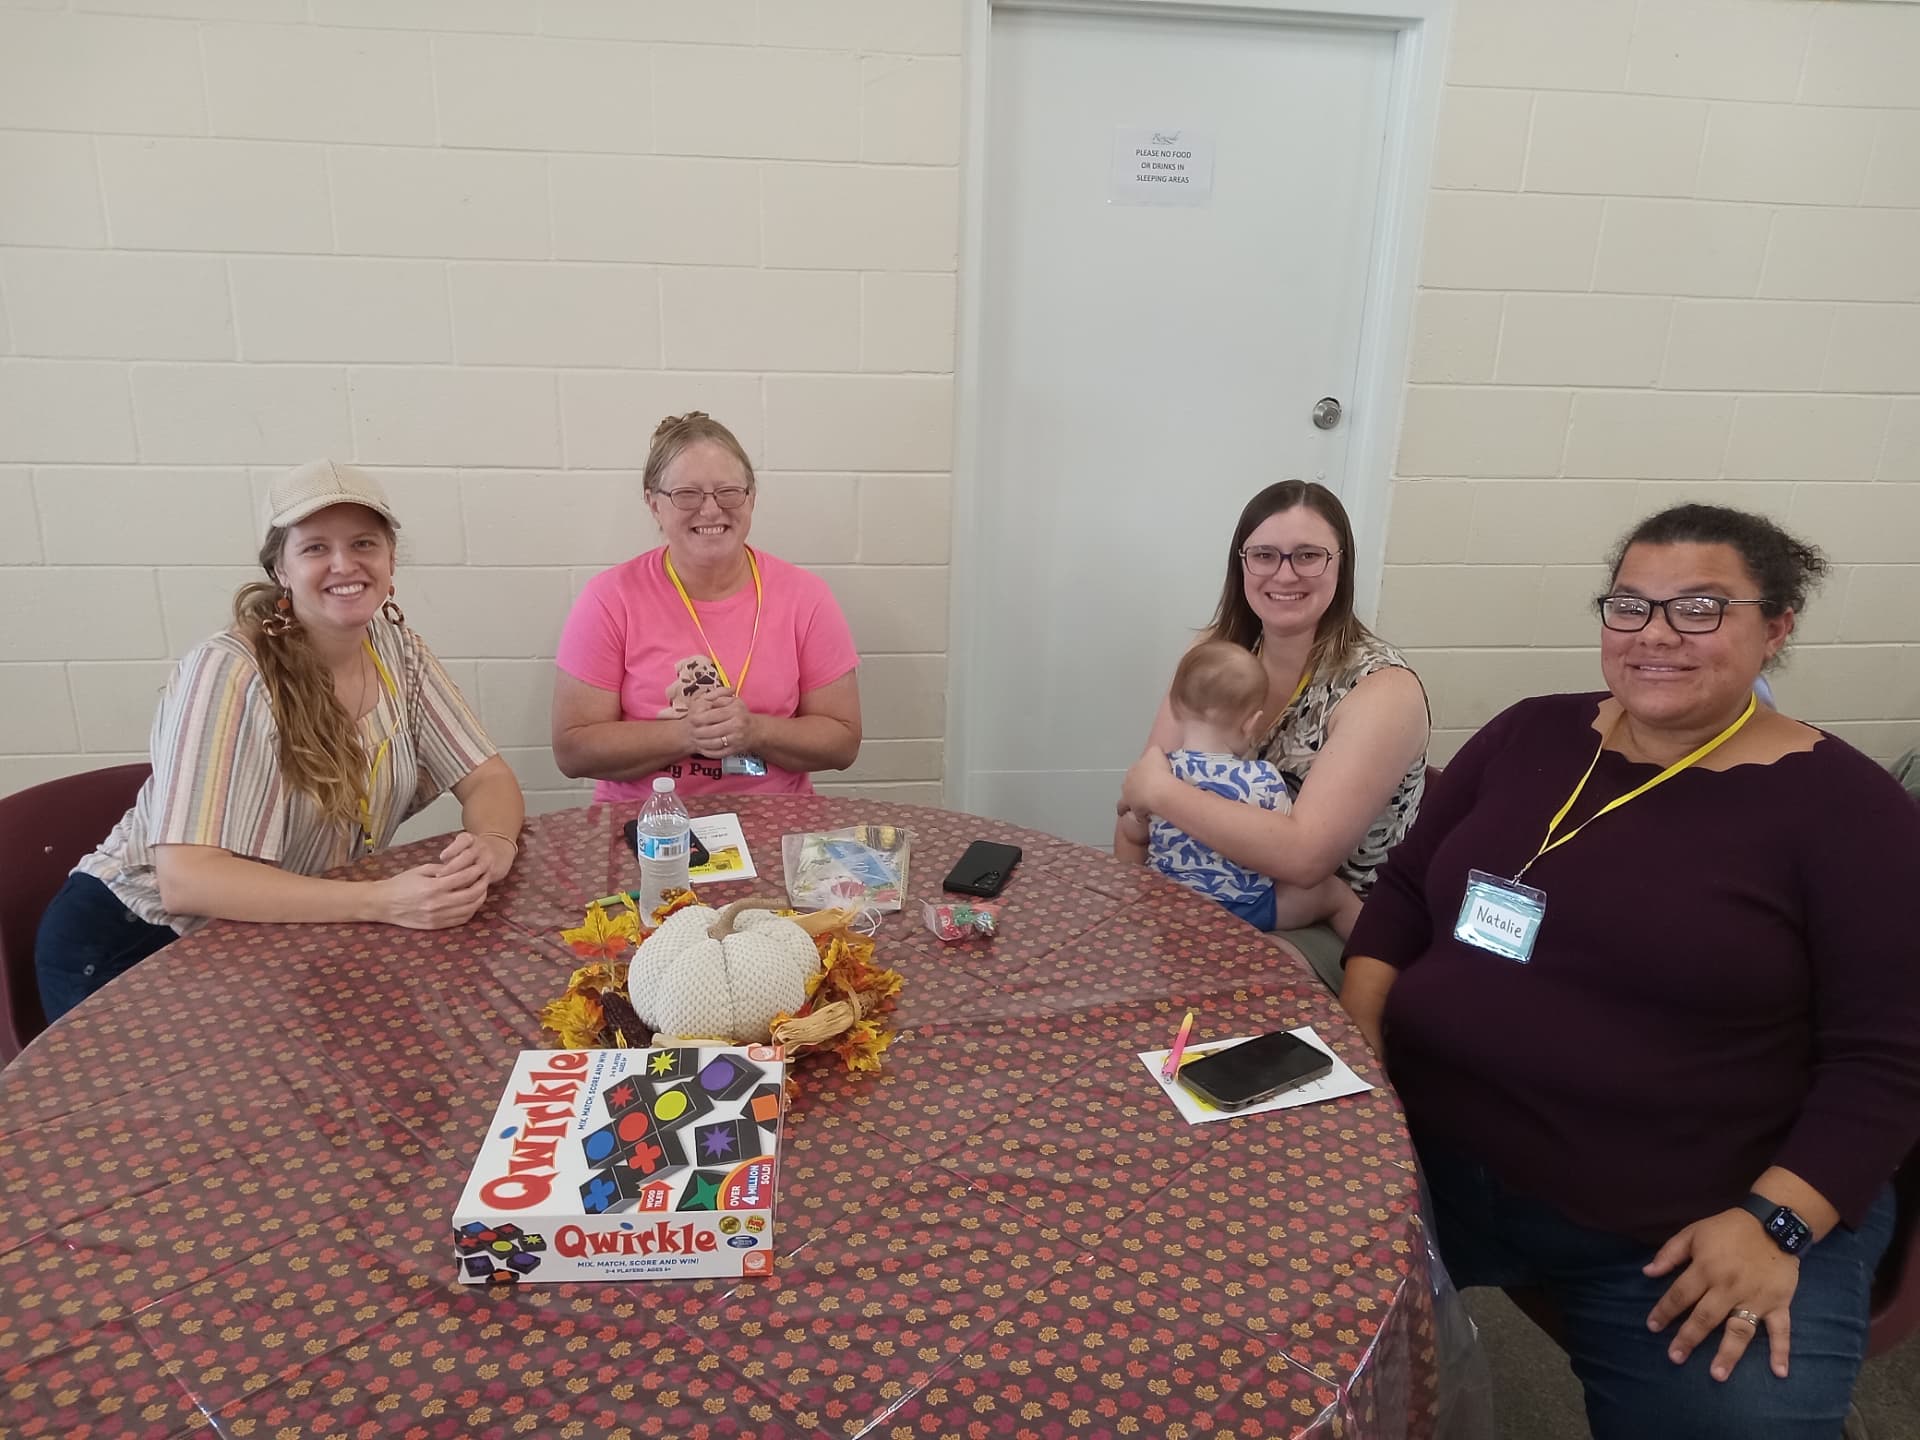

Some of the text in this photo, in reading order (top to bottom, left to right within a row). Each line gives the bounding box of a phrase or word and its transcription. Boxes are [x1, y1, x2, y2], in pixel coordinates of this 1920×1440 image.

[1136, 149, 1159, 157] PLEASE
[1172, 151, 1191, 159] FOOD
[1152, 162, 1176, 170] DRINKS
[1136, 174, 1167, 183] SLEEPING
[689, 762, 722, 780] Pug
[1476, 905, 1522, 938] Natalie
[588, 1076, 600, 1095] SCORE
[595, 1062, 604, 1077] AND
[479, 1051, 590, 1211] Qwirkle
[748, 1165, 759, 1194] MILLION
[761, 1164, 772, 1184] SOLD!
[646, 1190, 656, 1208] WOOD
[730, 1186, 741, 1206] OVER
[742, 1194, 759, 1205] 4
[554, 1221, 718, 1259] Qwirkle
